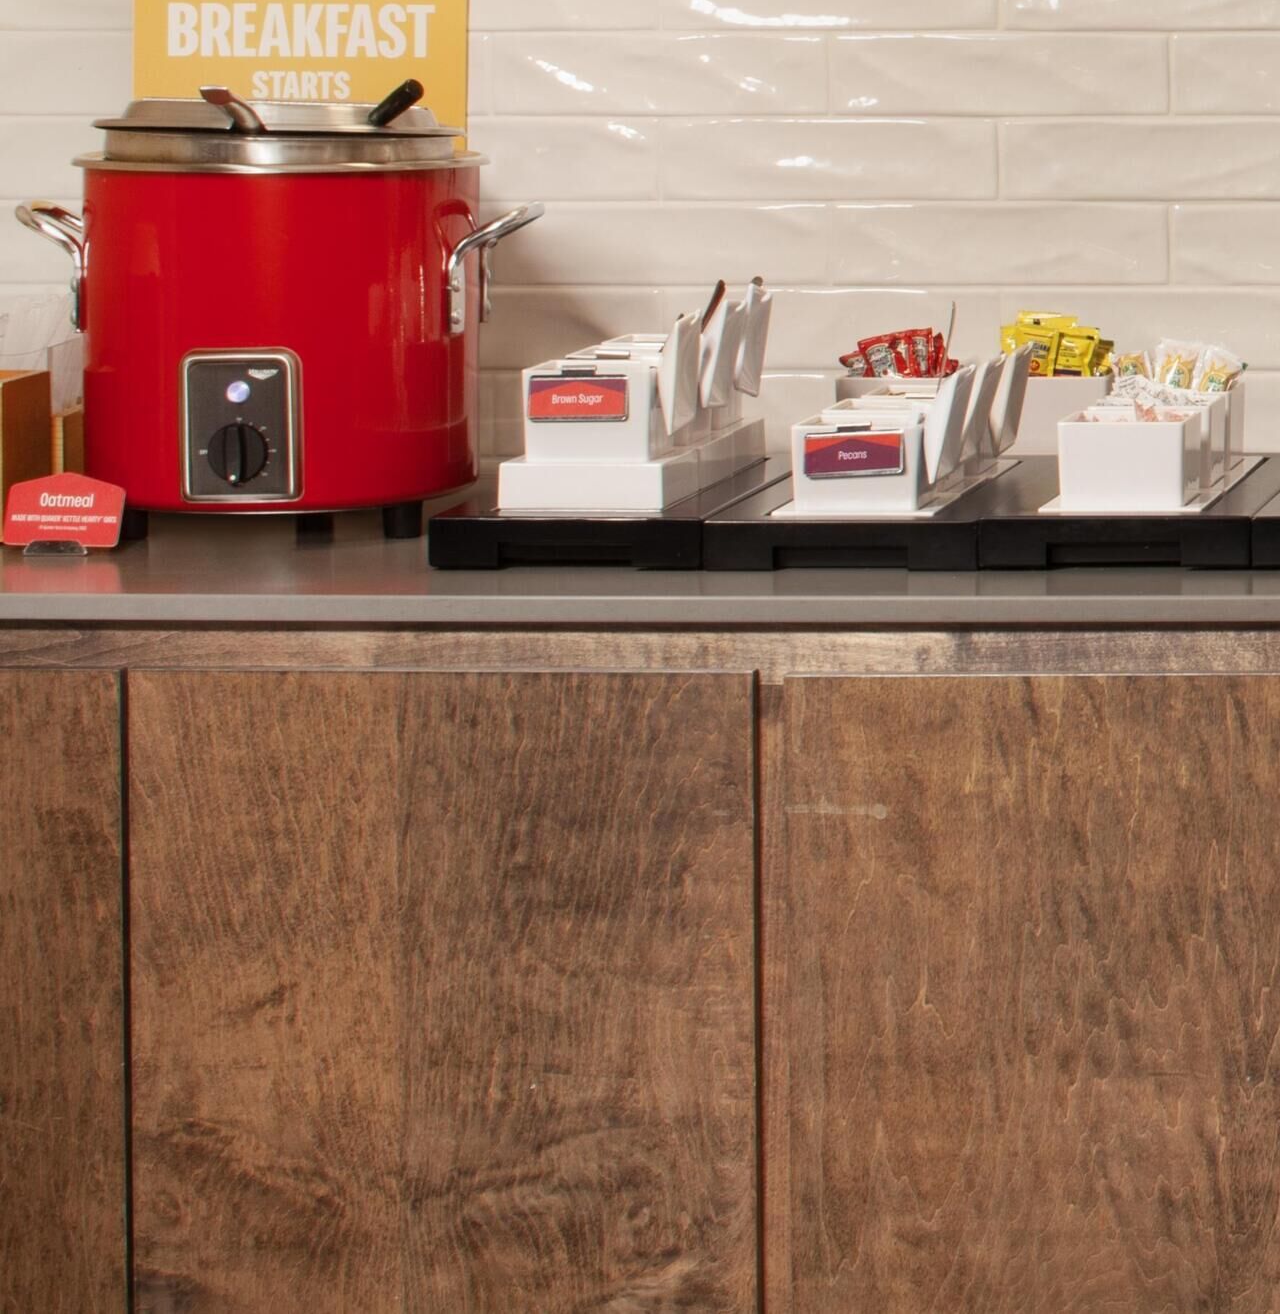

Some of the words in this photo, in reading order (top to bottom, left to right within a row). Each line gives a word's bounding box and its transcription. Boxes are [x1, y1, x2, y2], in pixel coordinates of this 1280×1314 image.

[167, 2, 436, 59] BREAKFAST
[251, 70, 351, 99] STARTS
[551, 394, 577, 405] Brown
[578, 393, 604, 406] Sugar
[838, 450, 868, 460] Pecans
[39, 492, 95, 508] Oatmeal
